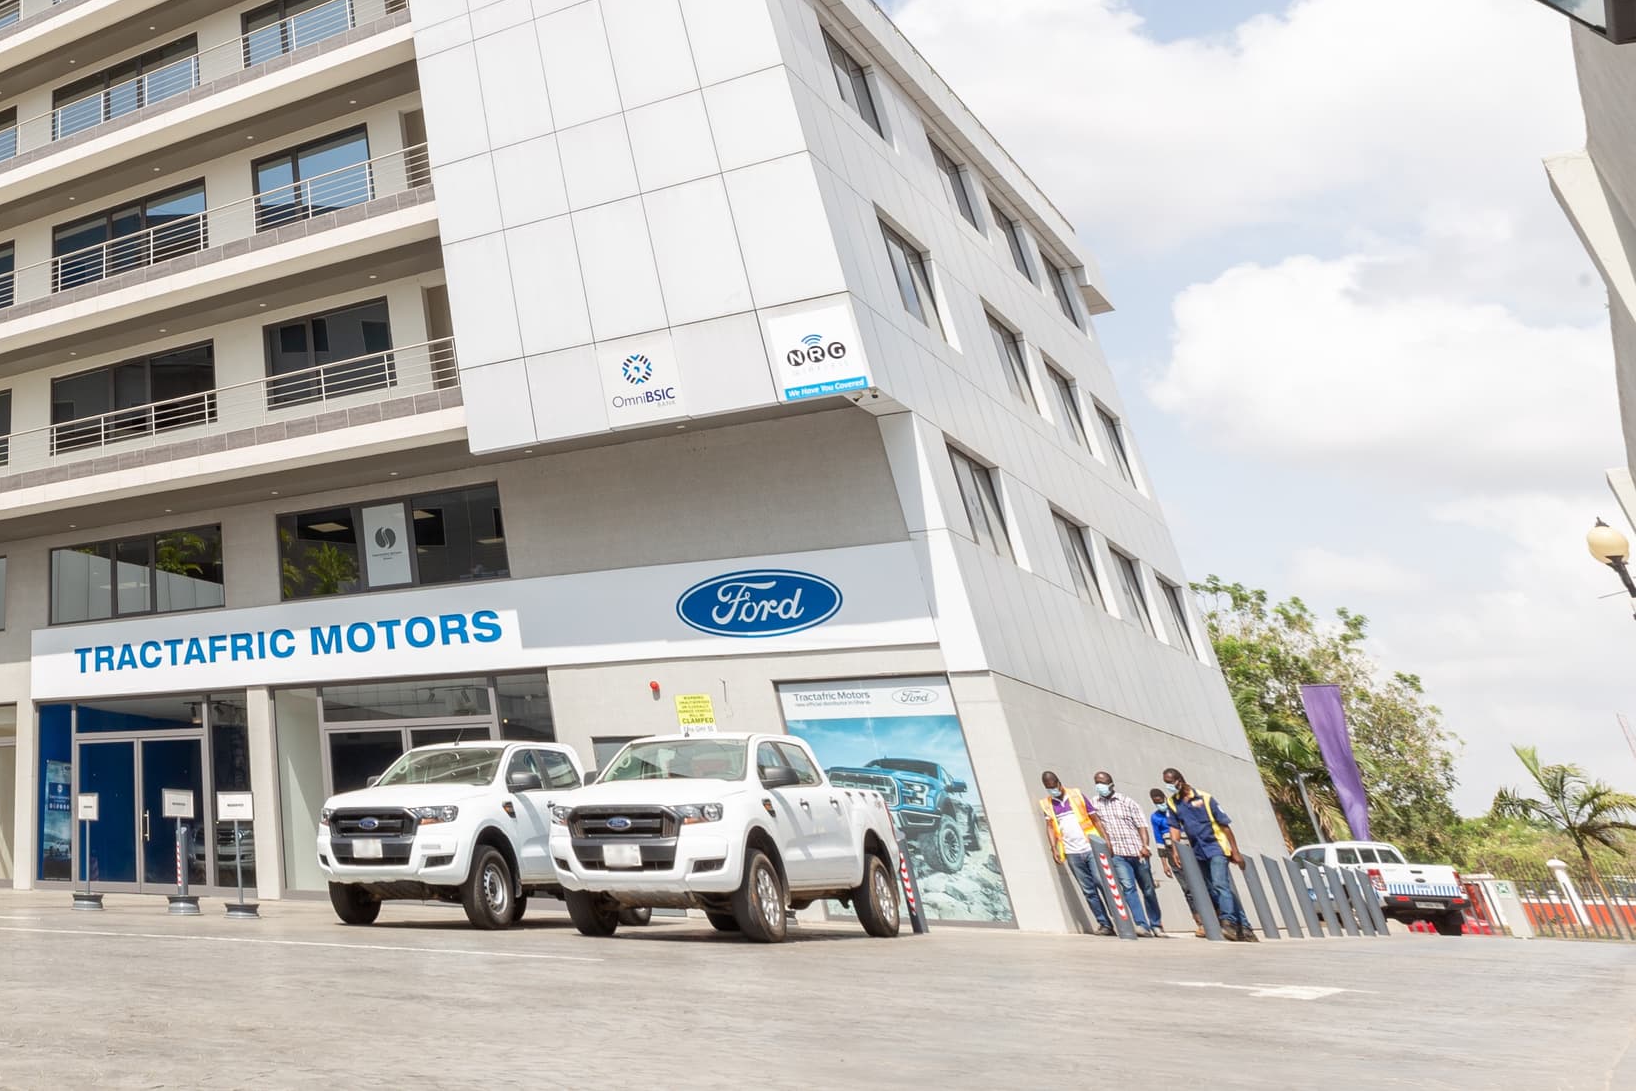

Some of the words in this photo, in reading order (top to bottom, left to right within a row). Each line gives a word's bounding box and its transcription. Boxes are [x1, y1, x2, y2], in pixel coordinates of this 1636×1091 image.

[786, 342, 846, 366] NRG
[612, 387, 676, 408] OmniBSIC
[788, 389, 800, 397] We
[801, 387, 820, 395] Have
[835, 379, 864, 390] Covered
[711, 581, 805, 625] Ford
[74, 628, 295, 673] TRACTAFRIC
[310, 610, 502, 655] MOTORS
[794, 692, 836, 702] Tractafric
[837, 691, 871, 700] Motors
[901, 690, 930, 703] Ford
